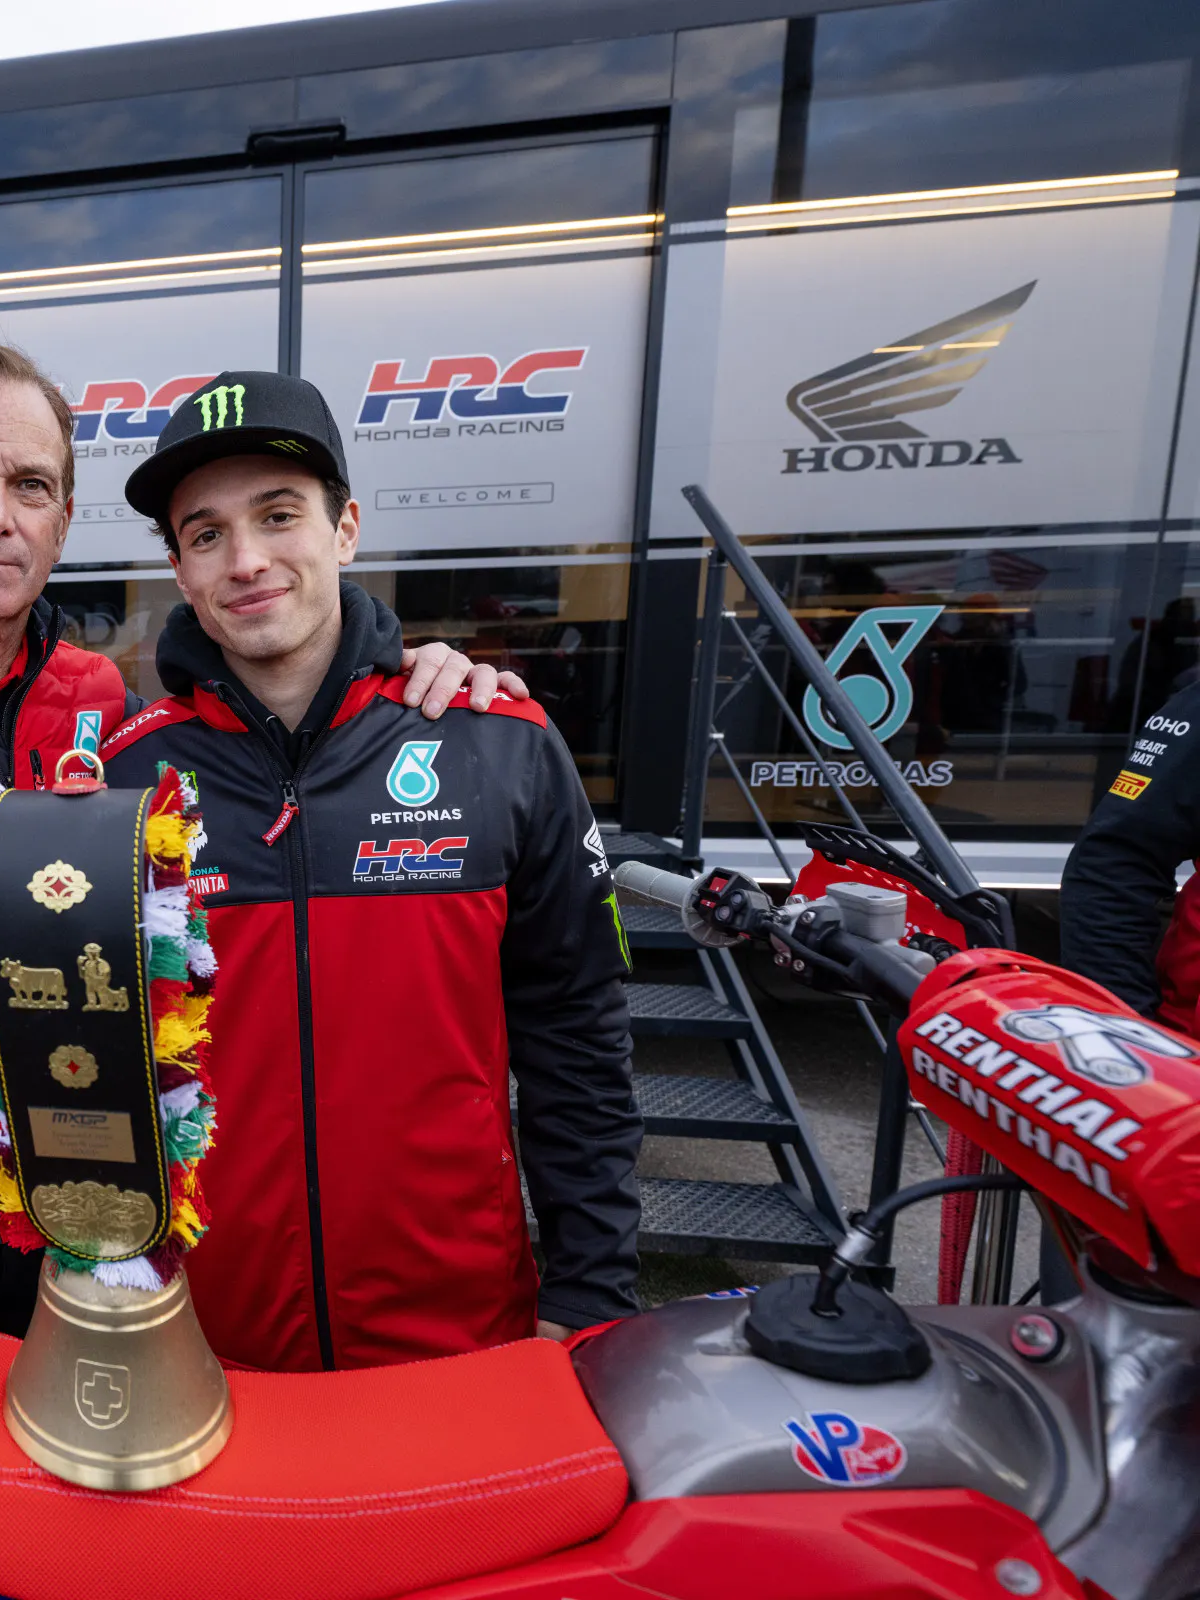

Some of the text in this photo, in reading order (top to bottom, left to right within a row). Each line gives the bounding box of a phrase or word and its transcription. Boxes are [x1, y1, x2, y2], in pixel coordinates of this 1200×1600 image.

[355, 346, 590, 427] HRC
[354, 419, 565, 442] Honda RACING
[780, 438, 1023, 475] HONDA
[397, 487, 533, 504] WELCOME
[266, 810, 290, 841] HONDA
[370, 808, 463, 825] PETRONAS
[189, 866, 220, 876] RONAS
[353, 836, 469, 875] HRC
[353, 871, 462, 882] Honda RACING
[914, 1012, 1142, 1161] RENTHAL
[912, 1047, 1128, 1211] RENTHAL
[787, 1413, 860, 1482] VP
